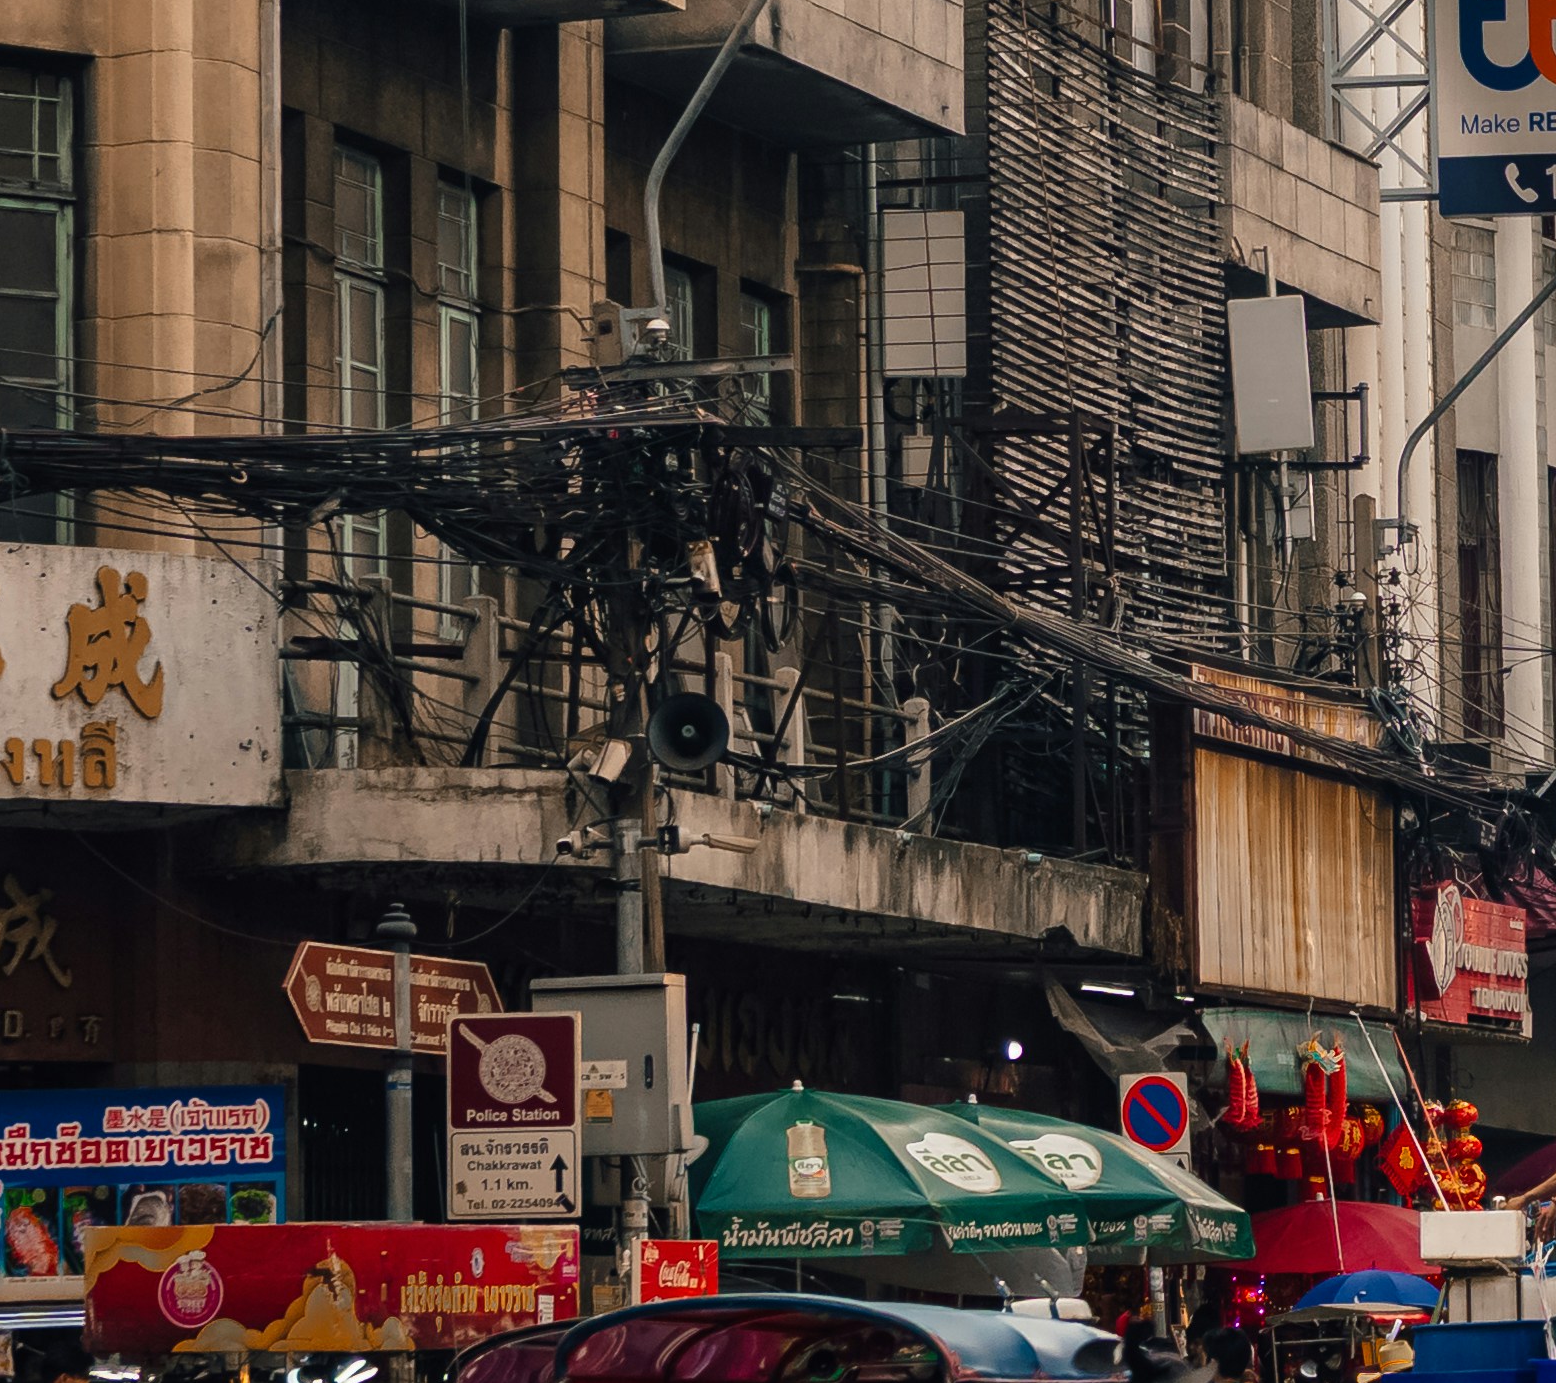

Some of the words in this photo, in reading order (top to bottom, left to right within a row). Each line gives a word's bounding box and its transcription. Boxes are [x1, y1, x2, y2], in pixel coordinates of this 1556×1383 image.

[1460, 113, 1522, 136] Make
[466, 1108, 508, 1123] Police
[511, 1107, 561, 1122] Station
[466, 1159, 543, 1172] Chakkrawat
[480, 1178, 505, 1192] 1.1
[509, 1178, 534, 1192] km.
[466, 1198, 489, 1211] Tel.
[723, 1216, 854, 1249] น้ำมันพืชลีลา
